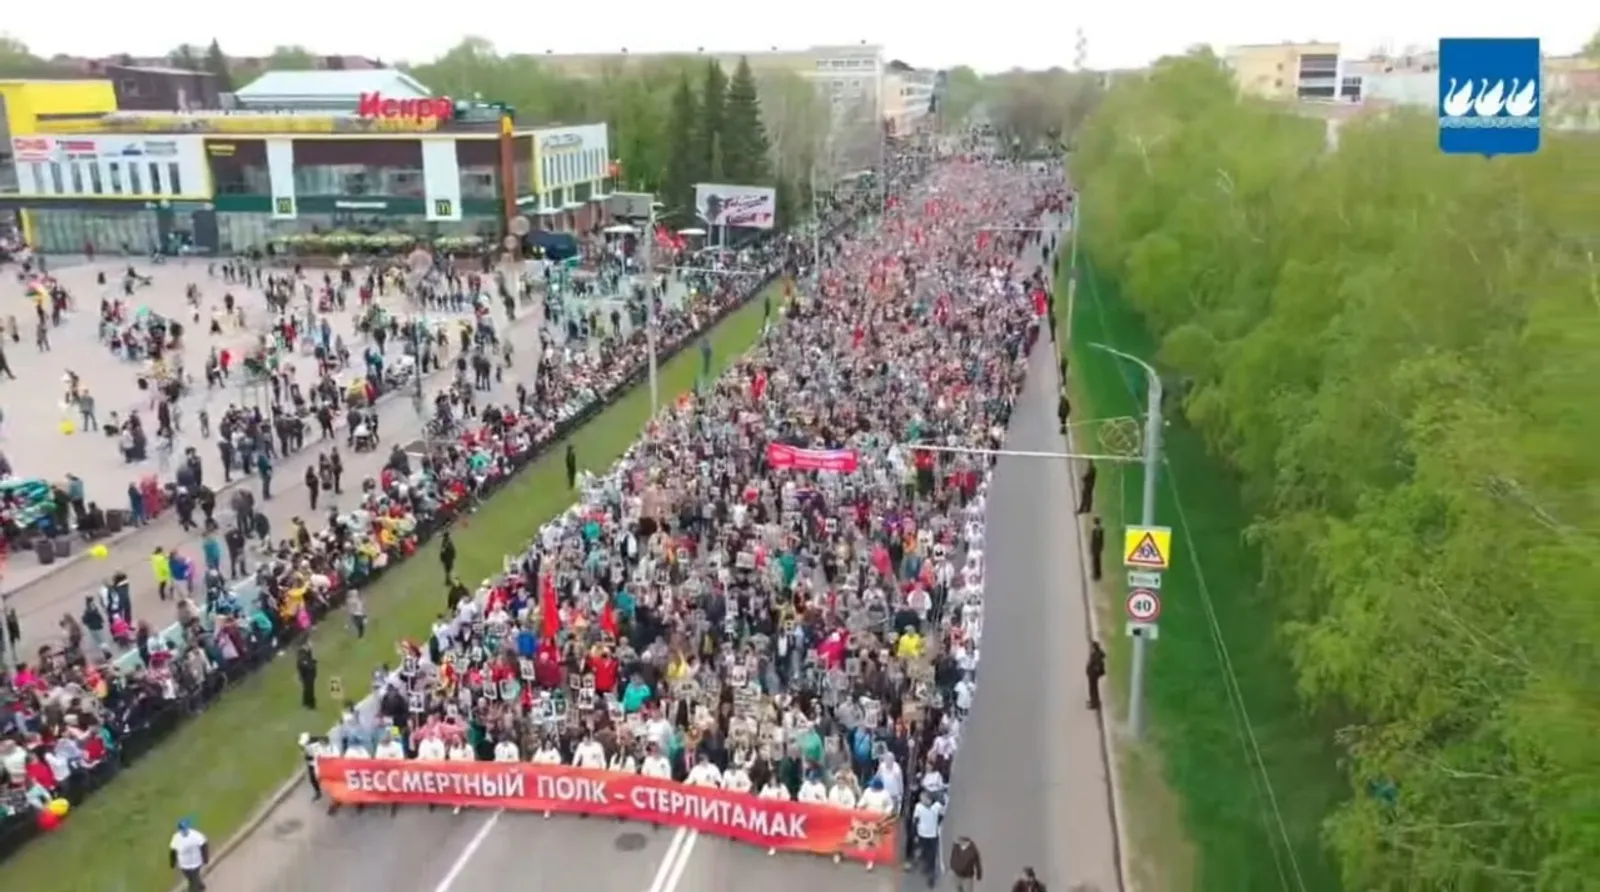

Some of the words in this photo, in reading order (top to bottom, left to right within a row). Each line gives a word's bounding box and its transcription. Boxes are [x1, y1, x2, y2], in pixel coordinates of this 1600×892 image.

[1134, 600, 1152, 612] 40
[345, 769, 524, 797] БЕССМЕРТНЫЙ
[537, 775, 608, 804] ПОЛК
[631, 786, 808, 839] СТЕРЛИТАМАК
